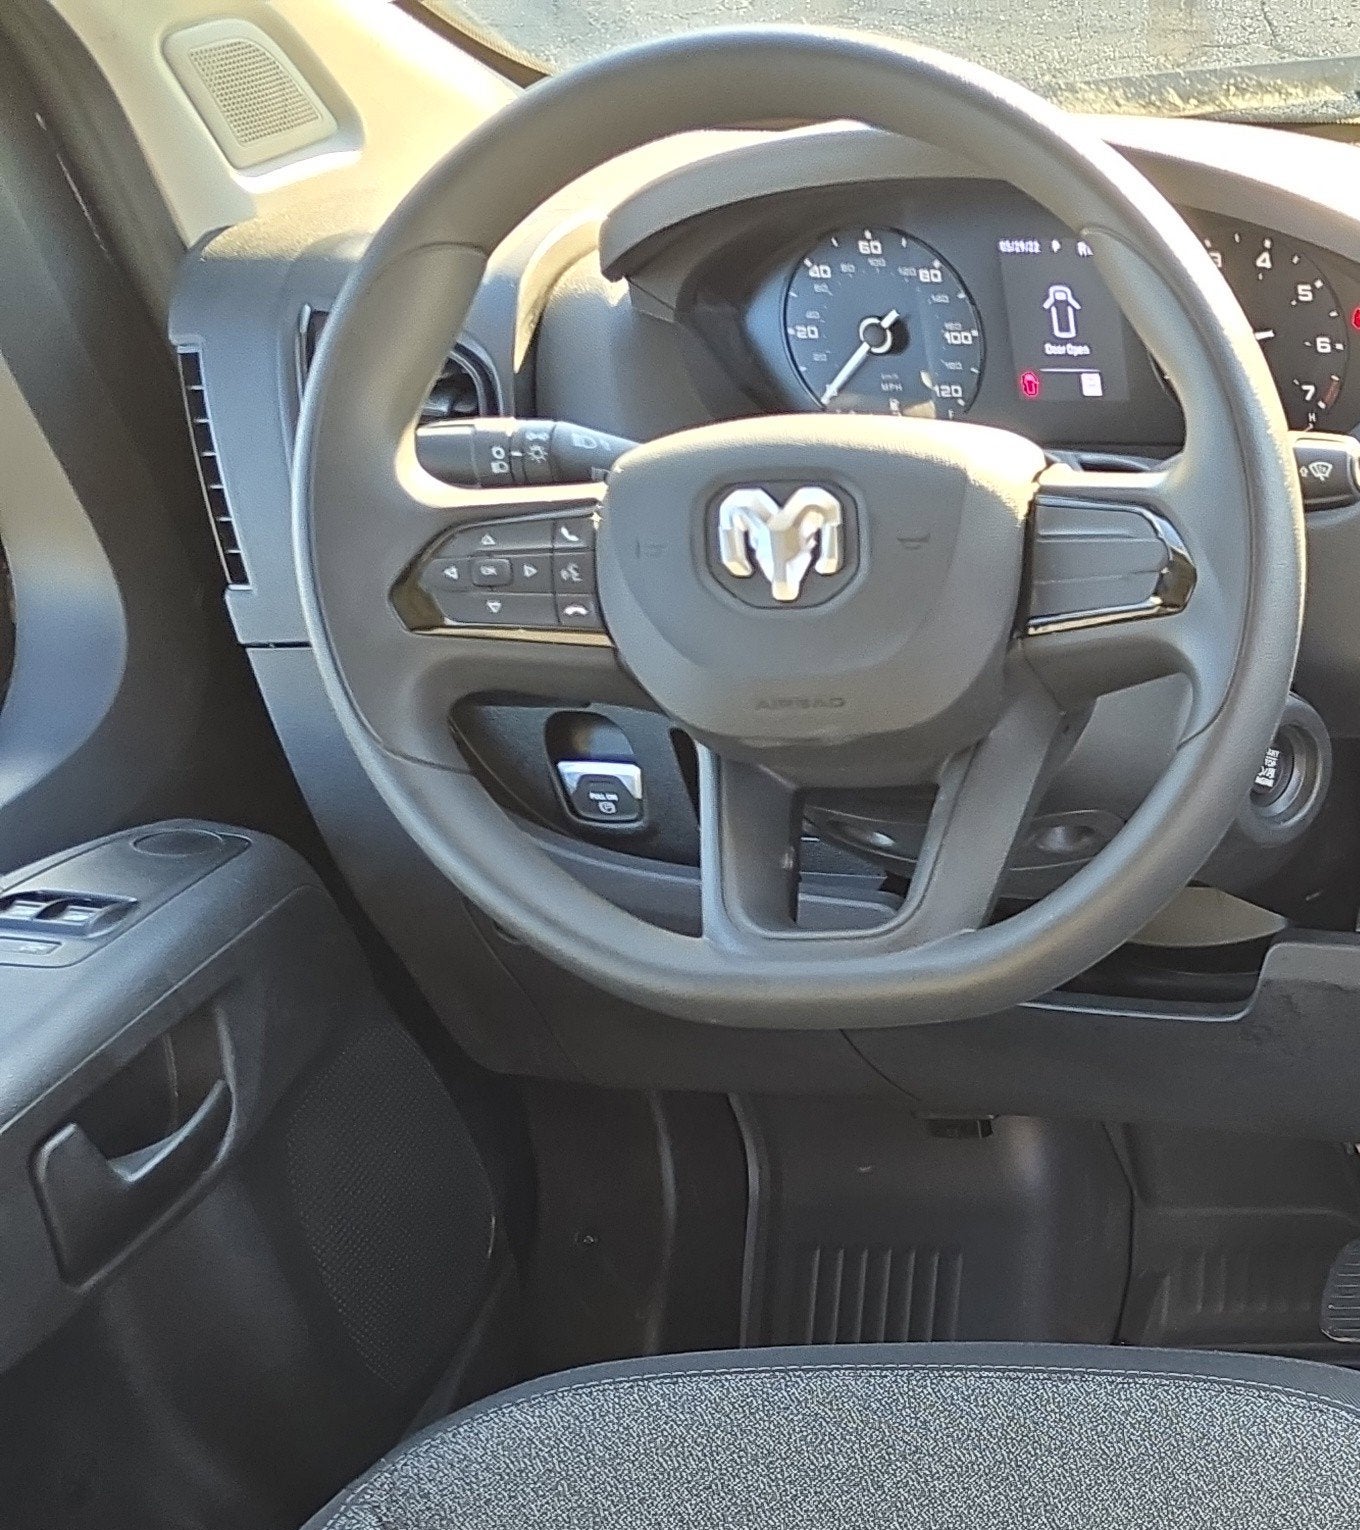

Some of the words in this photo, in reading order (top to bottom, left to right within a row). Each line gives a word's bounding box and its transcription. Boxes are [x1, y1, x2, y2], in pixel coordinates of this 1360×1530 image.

[858, 240, 882, 254] 60
[1256, 251, 1272, 268] 4
[809, 265, 831, 278] 40
[919, 269, 942, 282] 80
[1297, 284, 1313, 301] 5
[796, 326, 818, 339] 20
[944, 331, 972, 344] 100
[1316, 337, 1331, 353] 6
[934, 385, 963, 398] 120
[1302, 384, 1315, 401] 7
